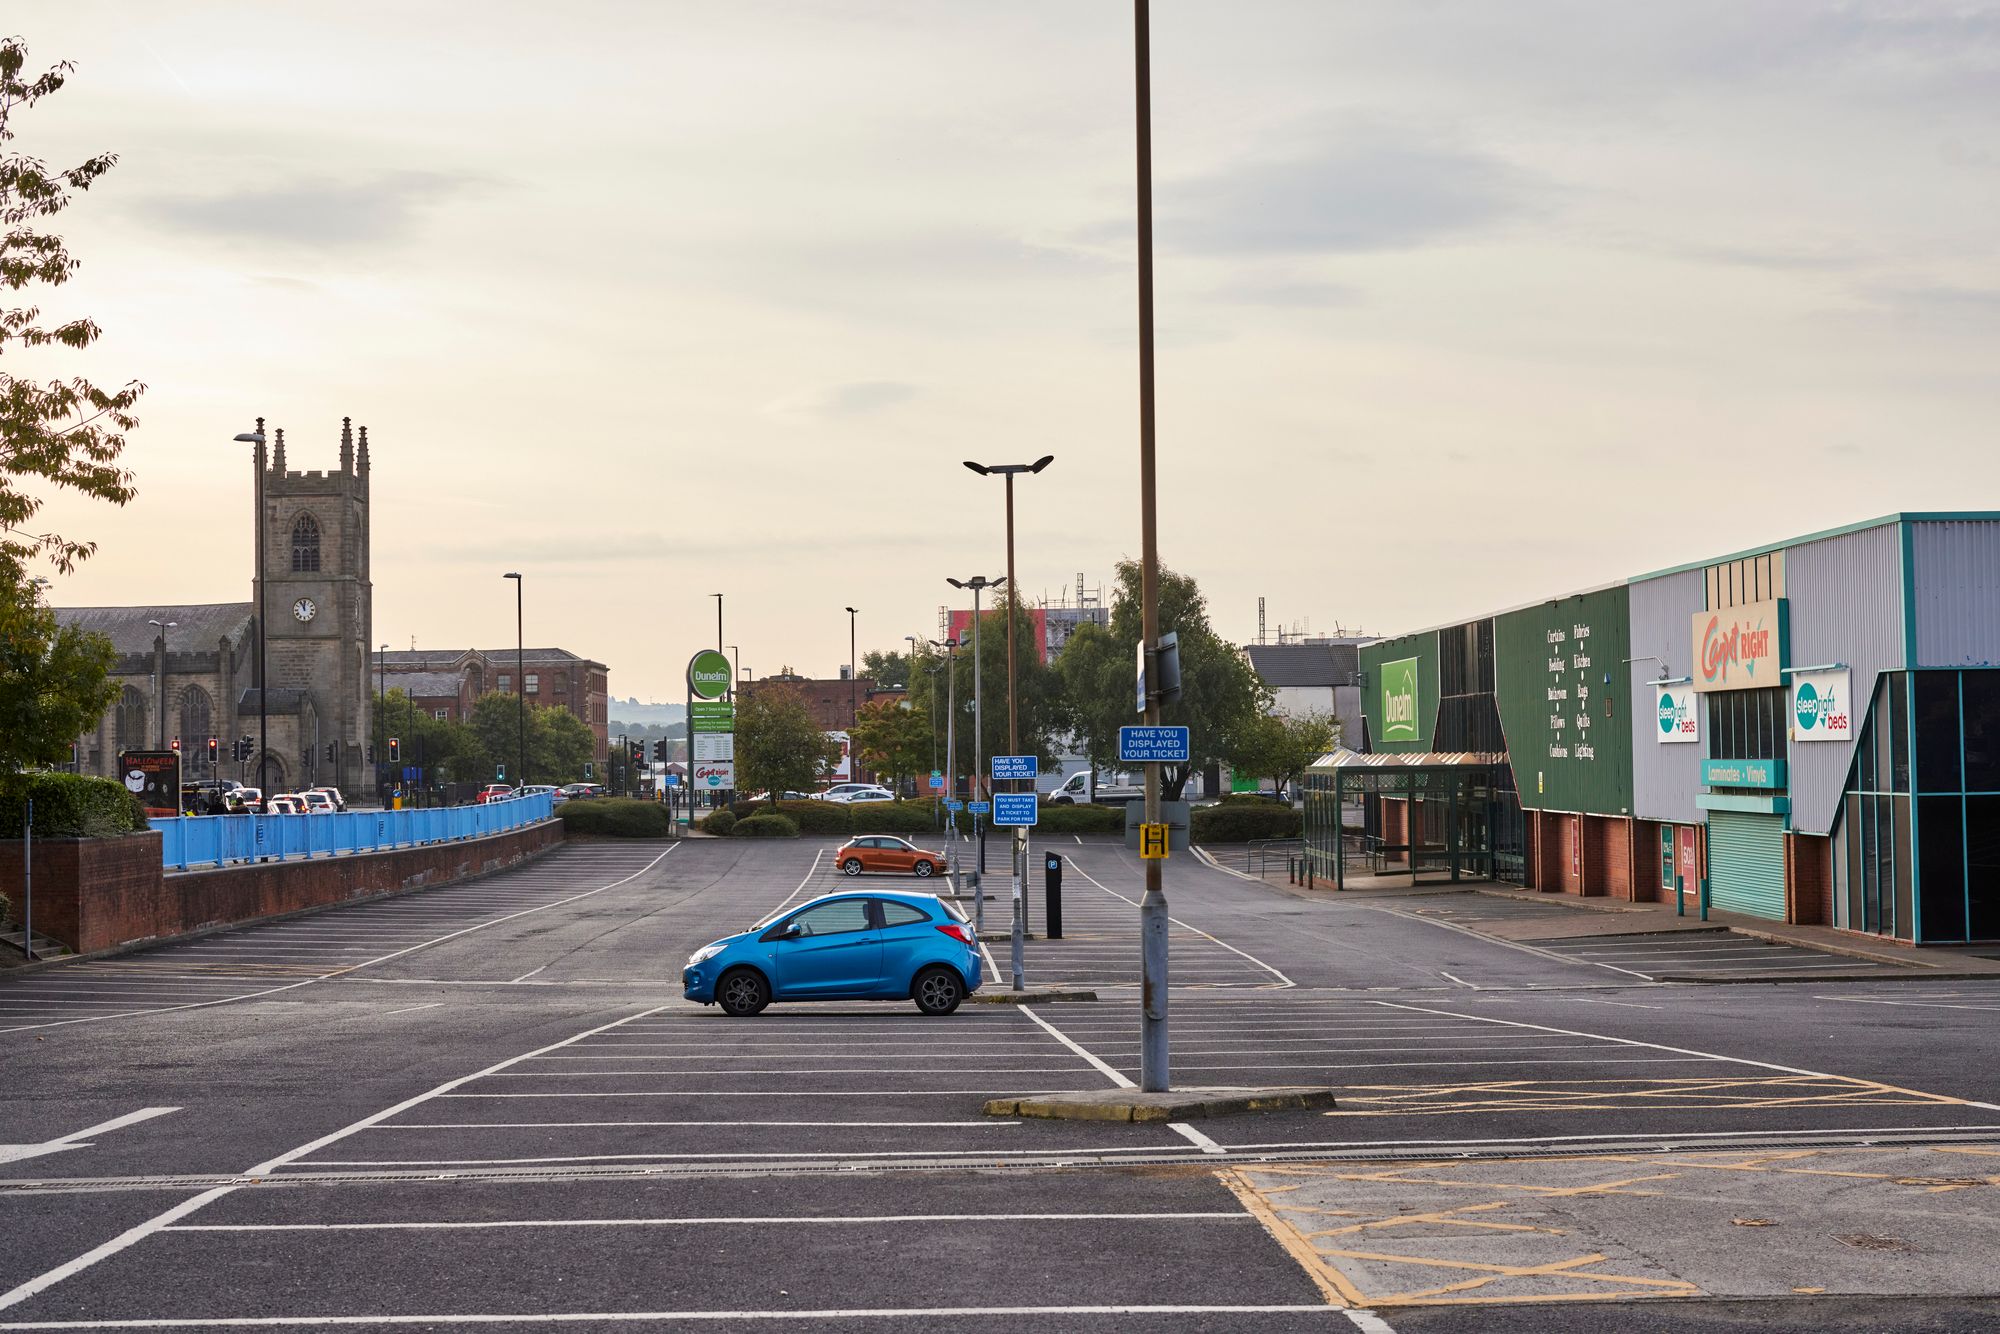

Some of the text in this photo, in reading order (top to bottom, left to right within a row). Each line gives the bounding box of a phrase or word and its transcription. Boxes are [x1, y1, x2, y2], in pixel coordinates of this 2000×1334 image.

[1547, 629, 1565, 643] Curtains
[1573, 623, 1590, 639] Fabrics
[1549, 657, 1565, 673] Bedding
[1573, 653, 1591, 669] Kitchen
[695, 671, 727, 681] Dunelm
[1548, 686, 1567, 700] Bathroom
[1577, 683, 1588, 700] Rugs
[1385, 687, 1412, 723] Dunelm
[1550, 714, 1565, 729] Pillows
[1576, 712, 1591, 730] Quilts
[1681, 718, 1695, 733] beds
[1828, 712, 1847, 729] beds
[1131, 730, 1178, 738] HAVE YOU
[1128, 740, 1180, 748] DISPLAYED
[1549, 743, 1568, 757] Cushions
[1574, 743, 1594, 760] Lighting
[126, 757, 175, 766] HALLOWEEN
[1124, 750, 1185, 758] YOUR TICKET
[1707, 764, 1767, 787] Laminates Vinyls
